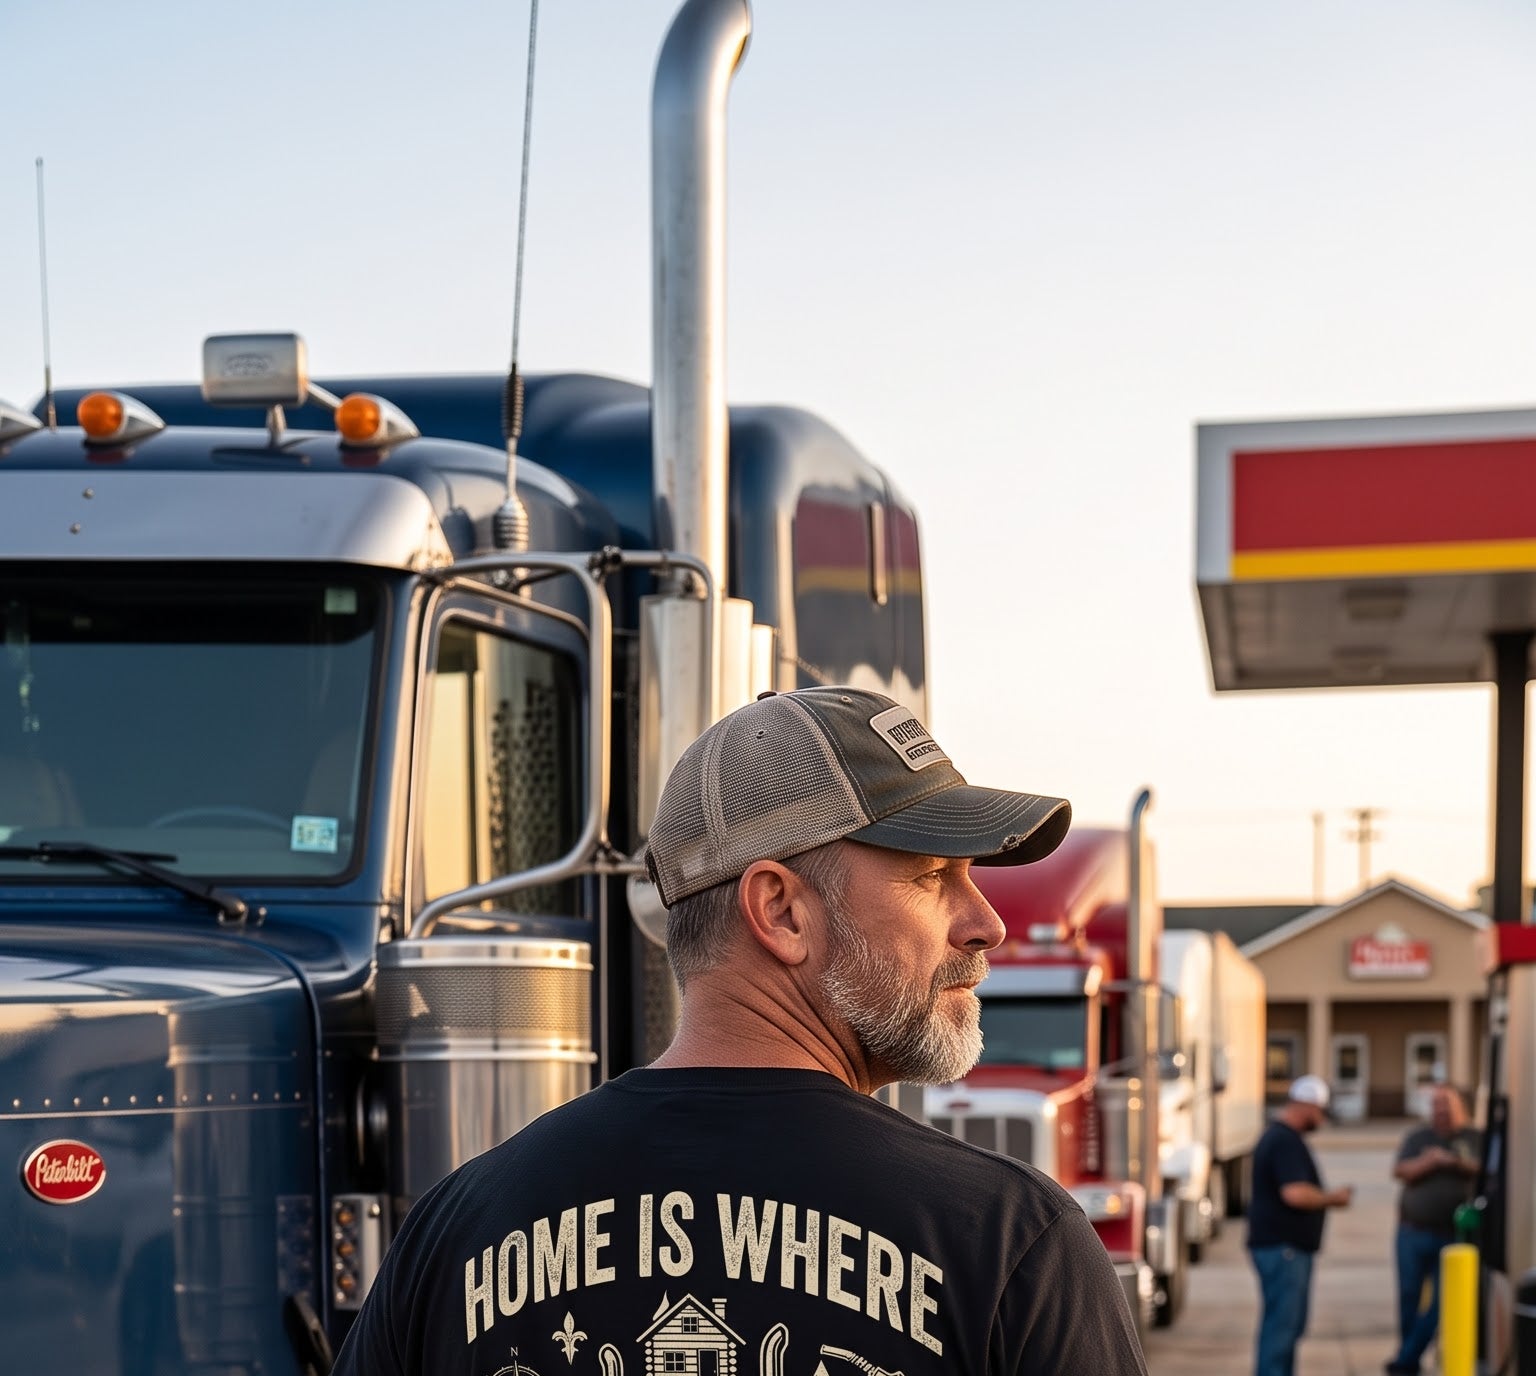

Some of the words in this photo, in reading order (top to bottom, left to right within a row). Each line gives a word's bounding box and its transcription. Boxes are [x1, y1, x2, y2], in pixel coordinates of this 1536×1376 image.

[464, 1198, 616, 1345] HOME
[638, 1190, 695, 1278] IS
[716, 1193, 944, 1357] WHERE
[510, 1346, 519, 1357] N
